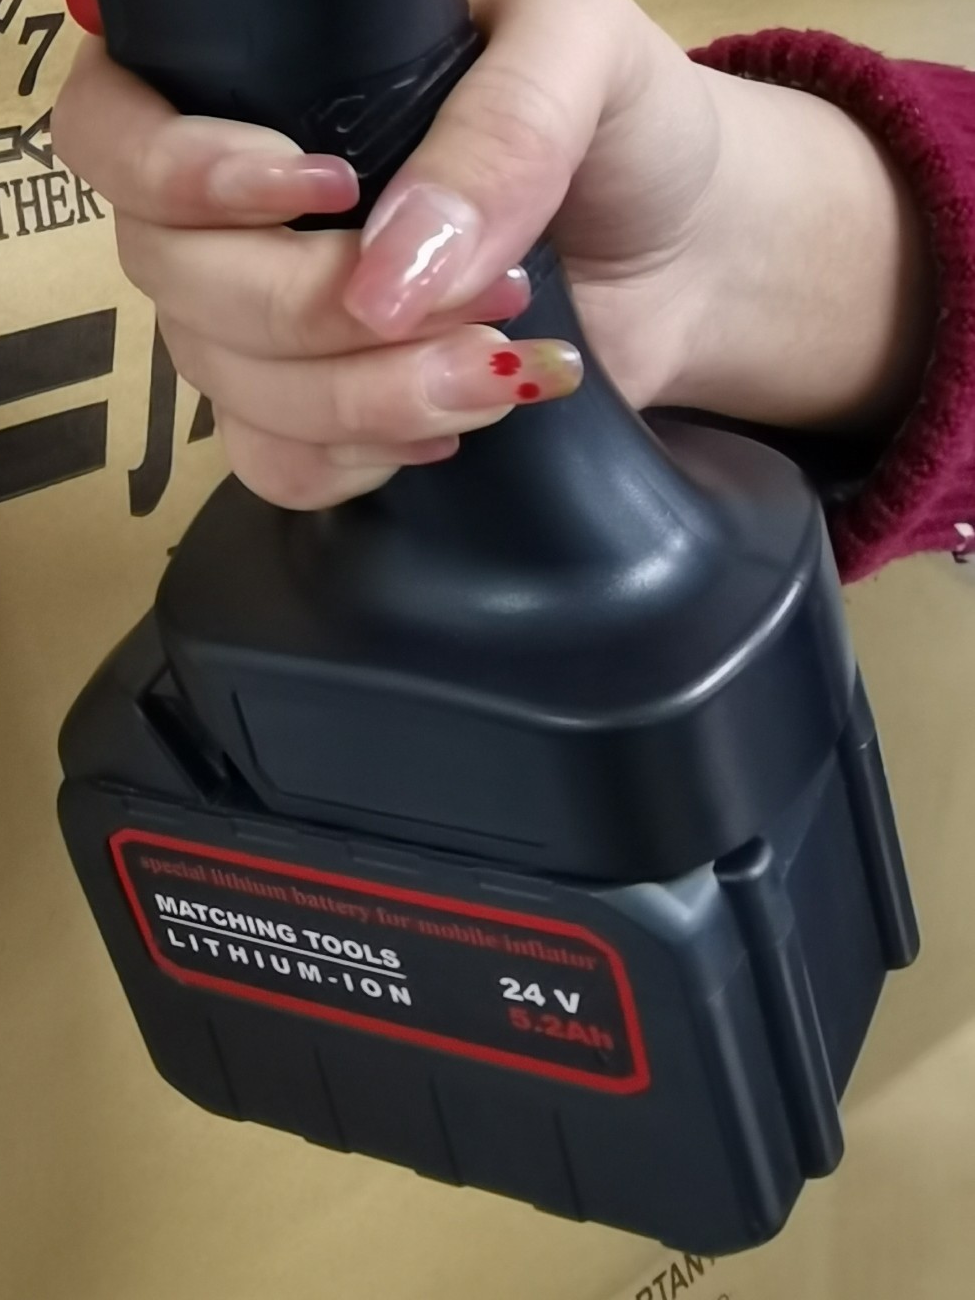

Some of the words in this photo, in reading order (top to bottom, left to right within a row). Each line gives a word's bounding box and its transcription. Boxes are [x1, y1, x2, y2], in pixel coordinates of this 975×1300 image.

[17, 12, 65, 97] 7
[141, 856, 208, 882] special
[211, 868, 288, 902] lithium
[291, 886, 372, 922] battery
[375, 905, 410, 929] for
[418, 919, 498, 948] mobile
[503, 933, 597, 970] inflator
[155, 893, 298, 944] MATCHING
[302, 929, 401, 969] TOOLS
[167, 928, 412, 1006] LITHIUM-ION
[499, 977, 546, 1007] 24
[553, 989, 580, 1014] V
[508, 1006, 614, 1050] 5.2Ah
